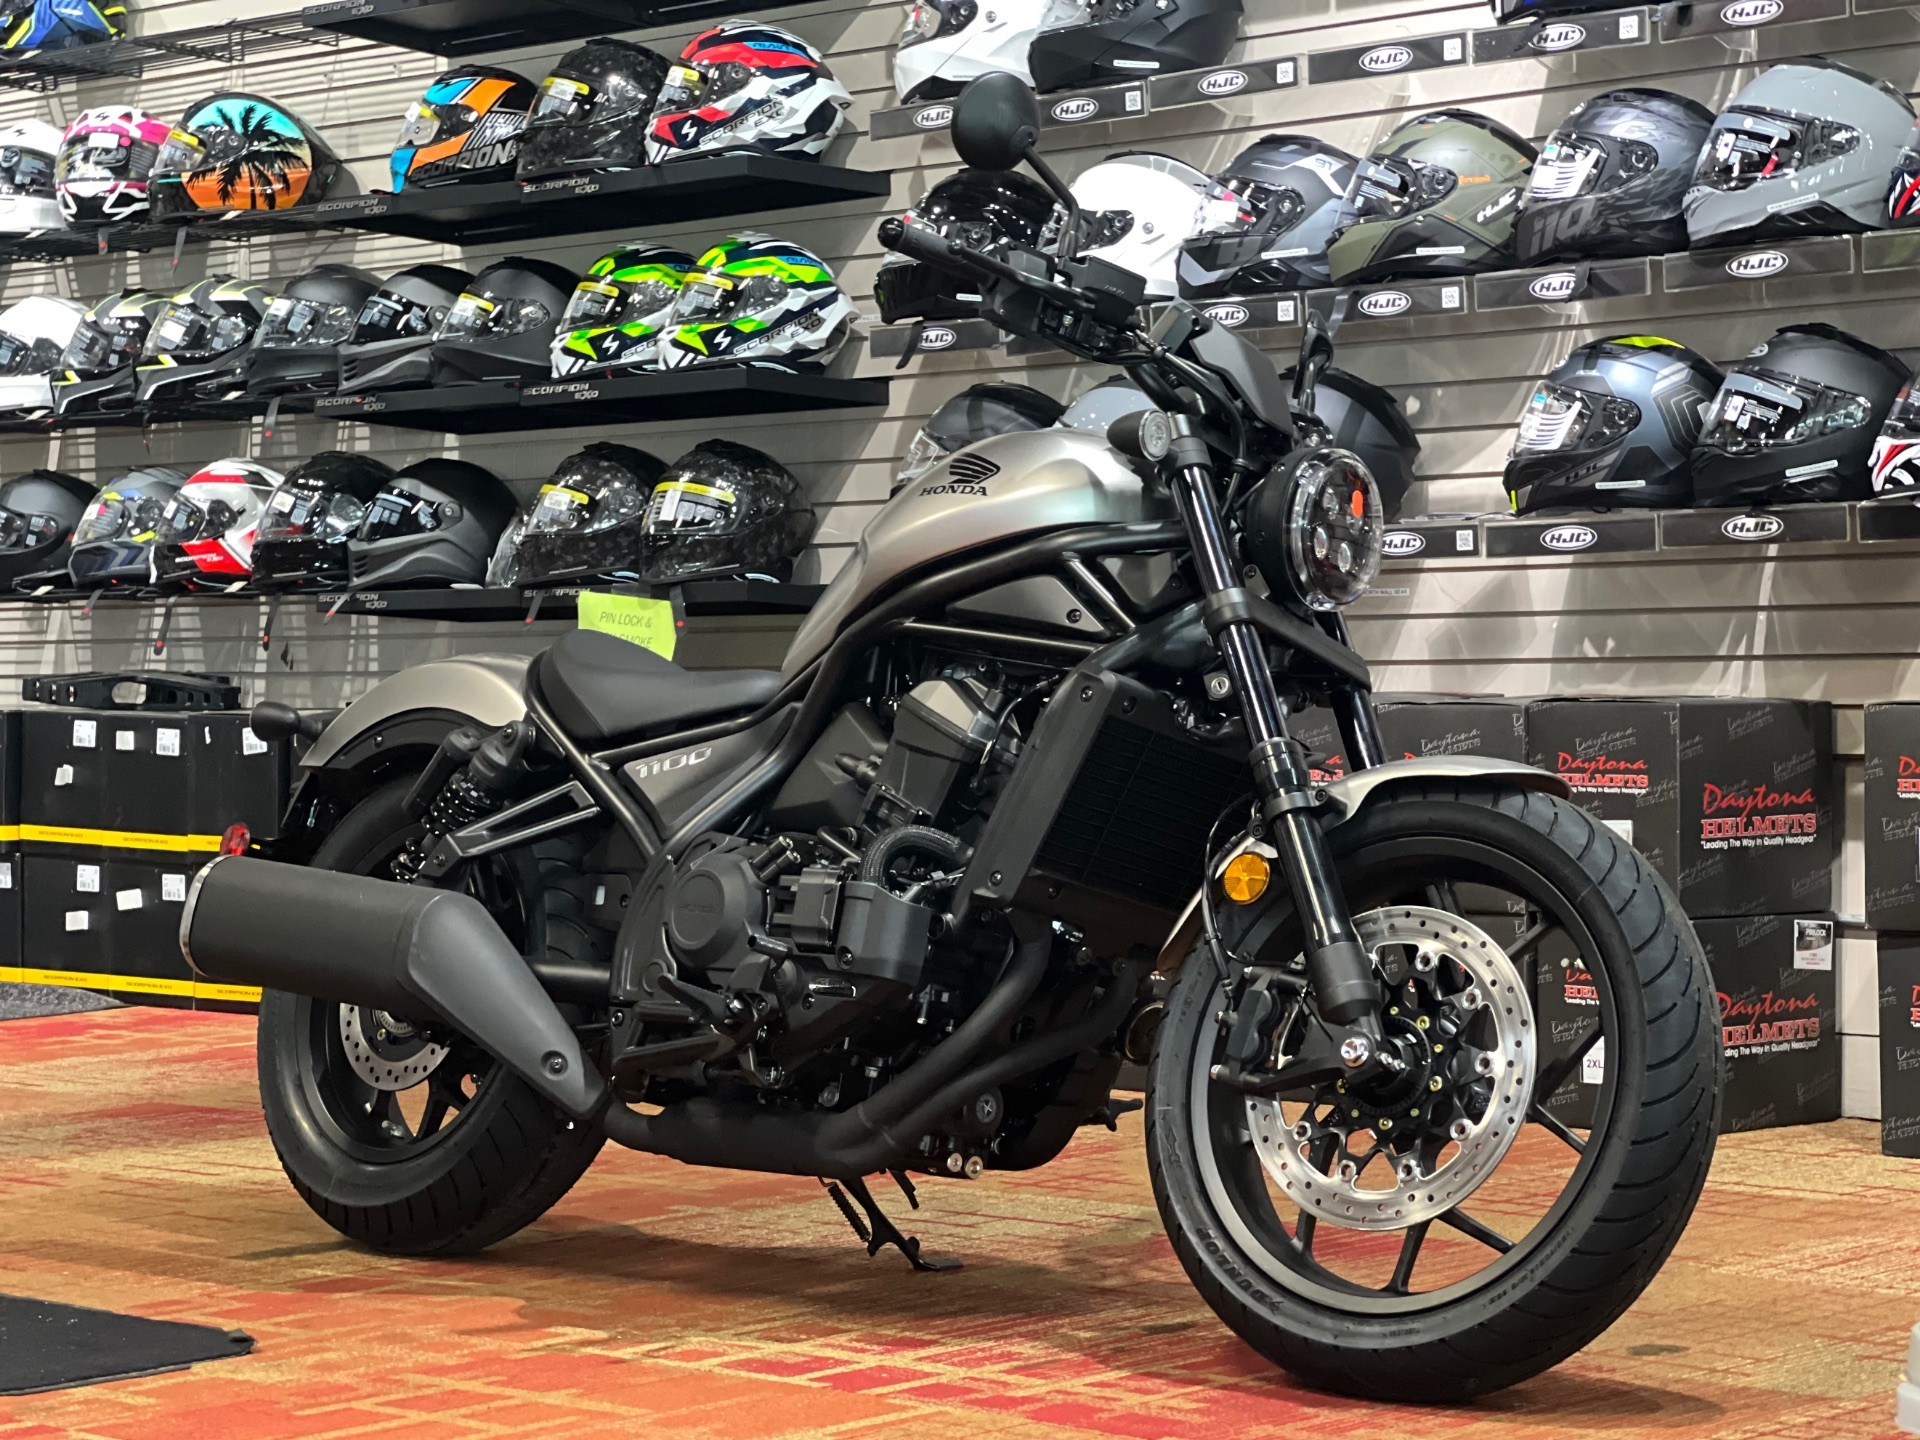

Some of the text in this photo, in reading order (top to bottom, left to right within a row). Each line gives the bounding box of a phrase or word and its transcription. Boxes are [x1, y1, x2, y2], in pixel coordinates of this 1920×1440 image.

[1730, 4, 1774, 20] HJC
[1536, 30, 1577, 46] HJC
[1367, 52, 1404, 66] HJC
[1206, 75, 1240, 90] HJC
[920, 109, 951, 123] HJC
[1059, 102, 1091, 116] HJC
[700, 99, 785, 146] SCORPION
[411, 139, 514, 181] SCORPION
[523, 176, 590, 192] SCORPION
[575, 183, 599, 194] EXO
[317, 198, 378, 212] SCORPION
[364, 205, 387, 215] EXO
[1735, 256, 1779, 270] HJC
[1366, 297, 1403, 310] HJC
[733, 307, 820, 356] SCORPION
[790, 318, 822, 339] EXO
[523, 383, 590, 396] SCORPION
[574, 390, 599, 400] EXO
[363, 402, 386, 411] EXO
[918, 485, 988, 496] HONDA
[1731, 521, 1774, 533] HJC
[1383, 538, 1418, 549] HJC
[1549, 532, 1589, 544] HJC
[365, 600, 388, 609] EXO
[600, 611, 652, 628] PIN LOCK &
[635, 747, 712, 778] 1100
[1557, 751, 1649, 776] Daytona
[1703, 782, 1815, 822] Daytona
[1700, 813, 1817, 840] HELMETS
[1701, 834, 1817, 850] "Leading The Way In Quality Headgear"
[1740, 1046, 1750, 1056] The
[1751, 1044, 1763, 1055] Way
[1764, 1044, 1770, 1053] In
[1771, 1042, 1790, 1052] Quality
[1587, 1059, 1604, 1069] 2XL
